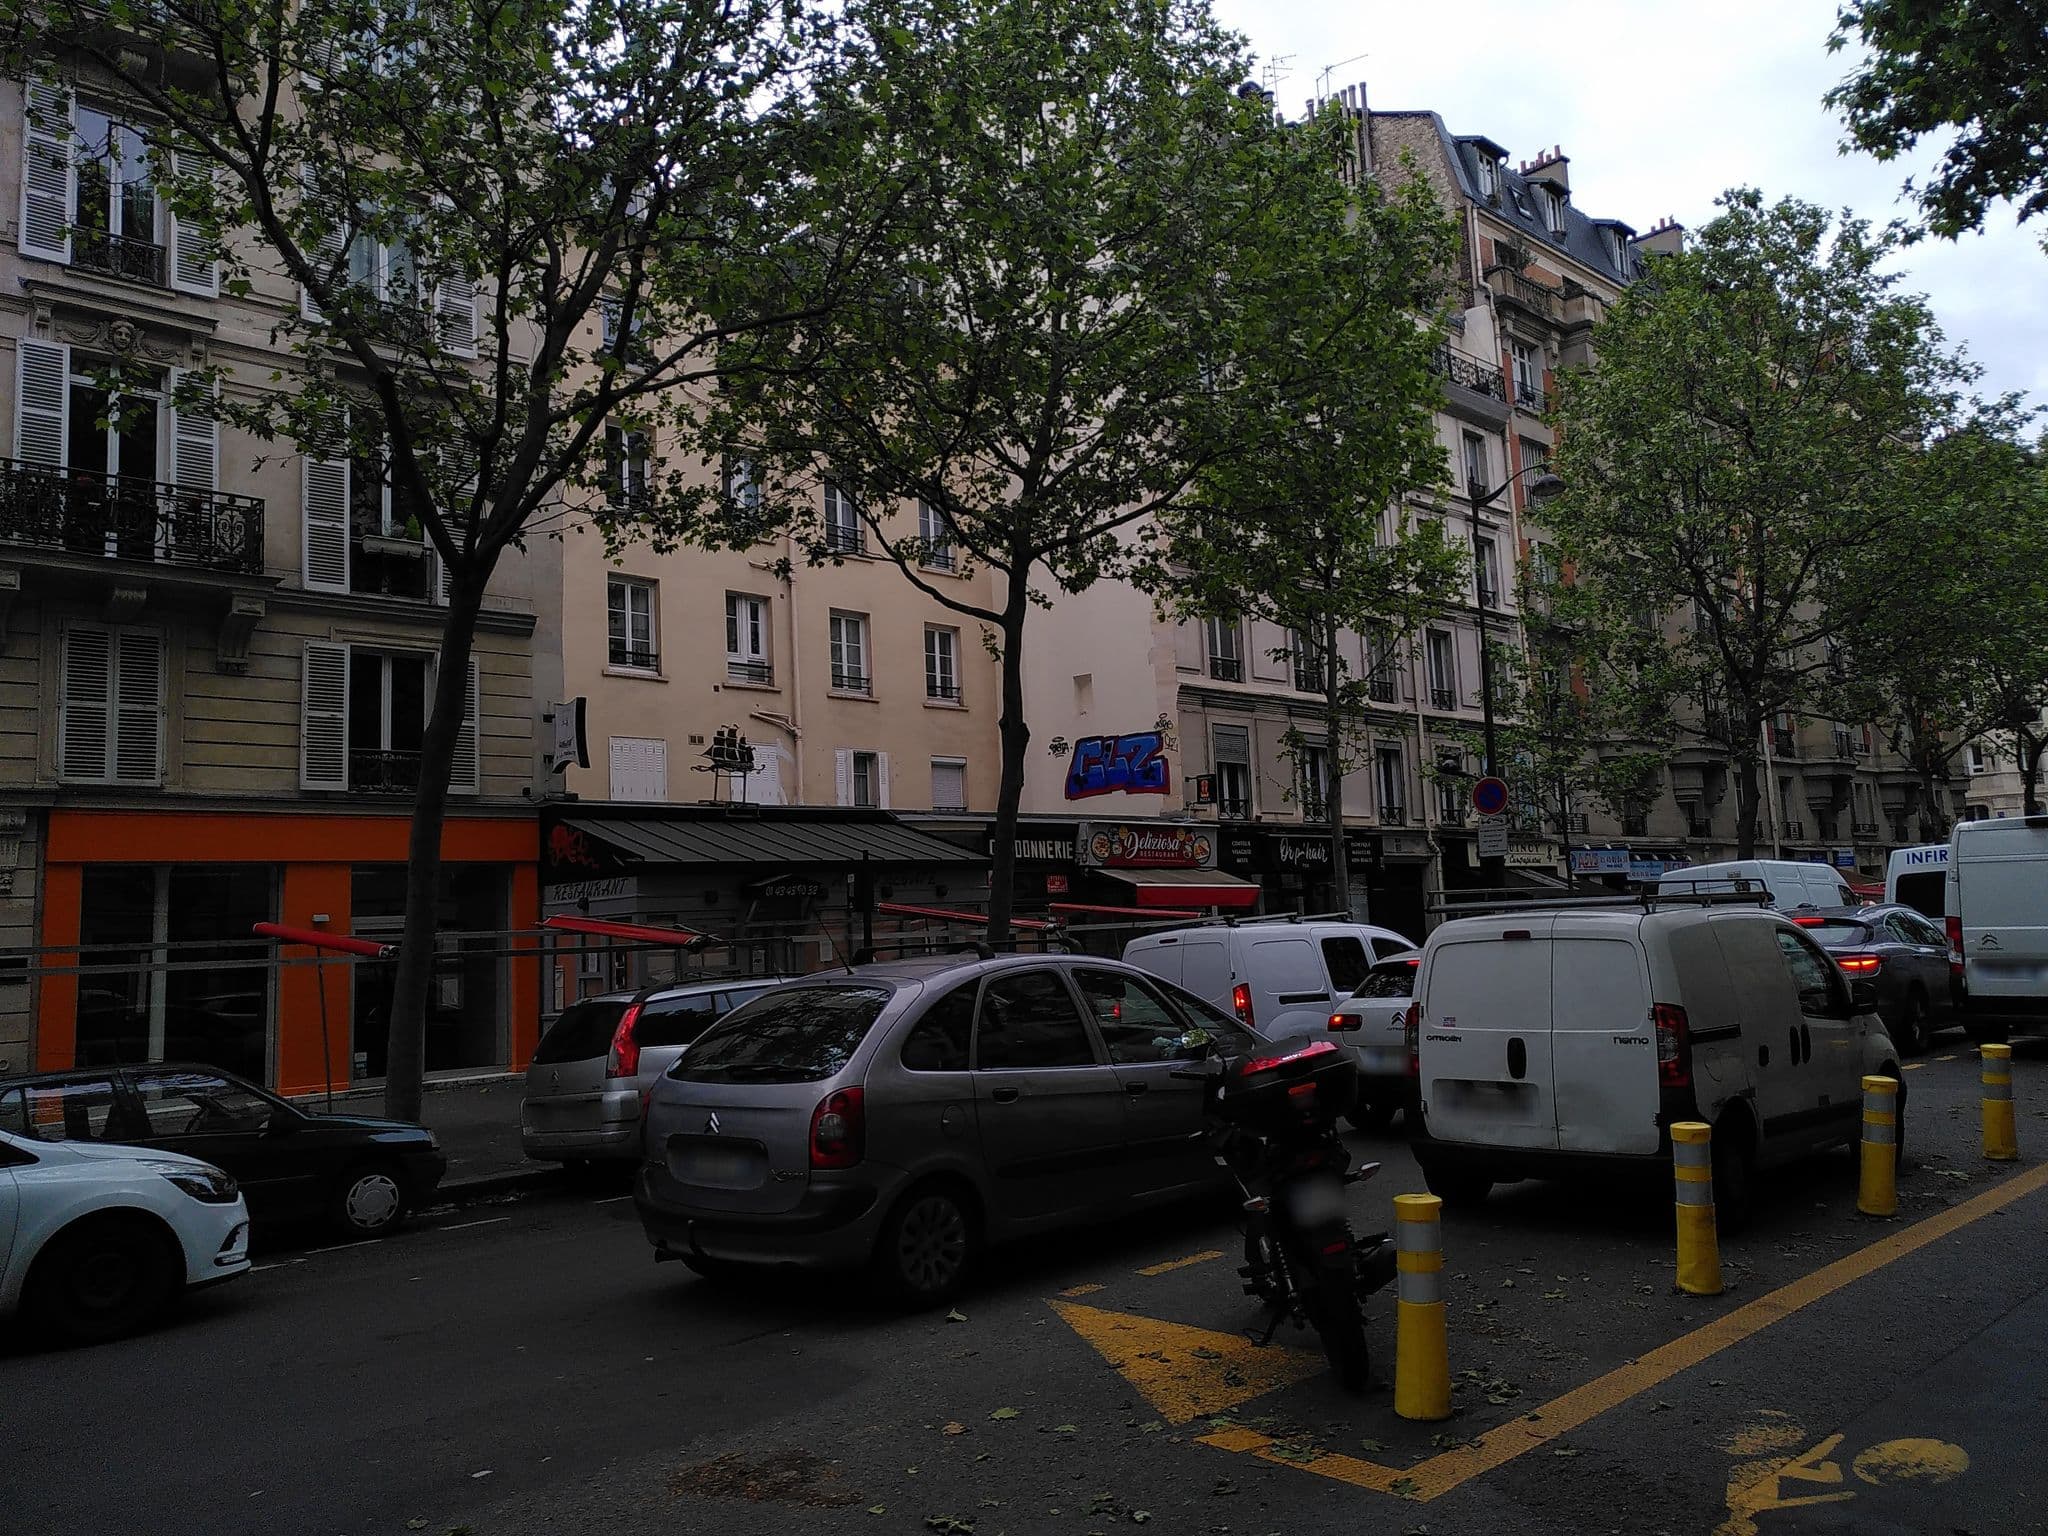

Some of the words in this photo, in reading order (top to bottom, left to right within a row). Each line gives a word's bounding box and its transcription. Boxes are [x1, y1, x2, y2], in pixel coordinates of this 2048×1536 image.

[988, 838, 1074, 860] CDONNERIE
[1123, 831, 1180, 859] Deliziosa
[1906, 849, 1949, 865] INFIR
